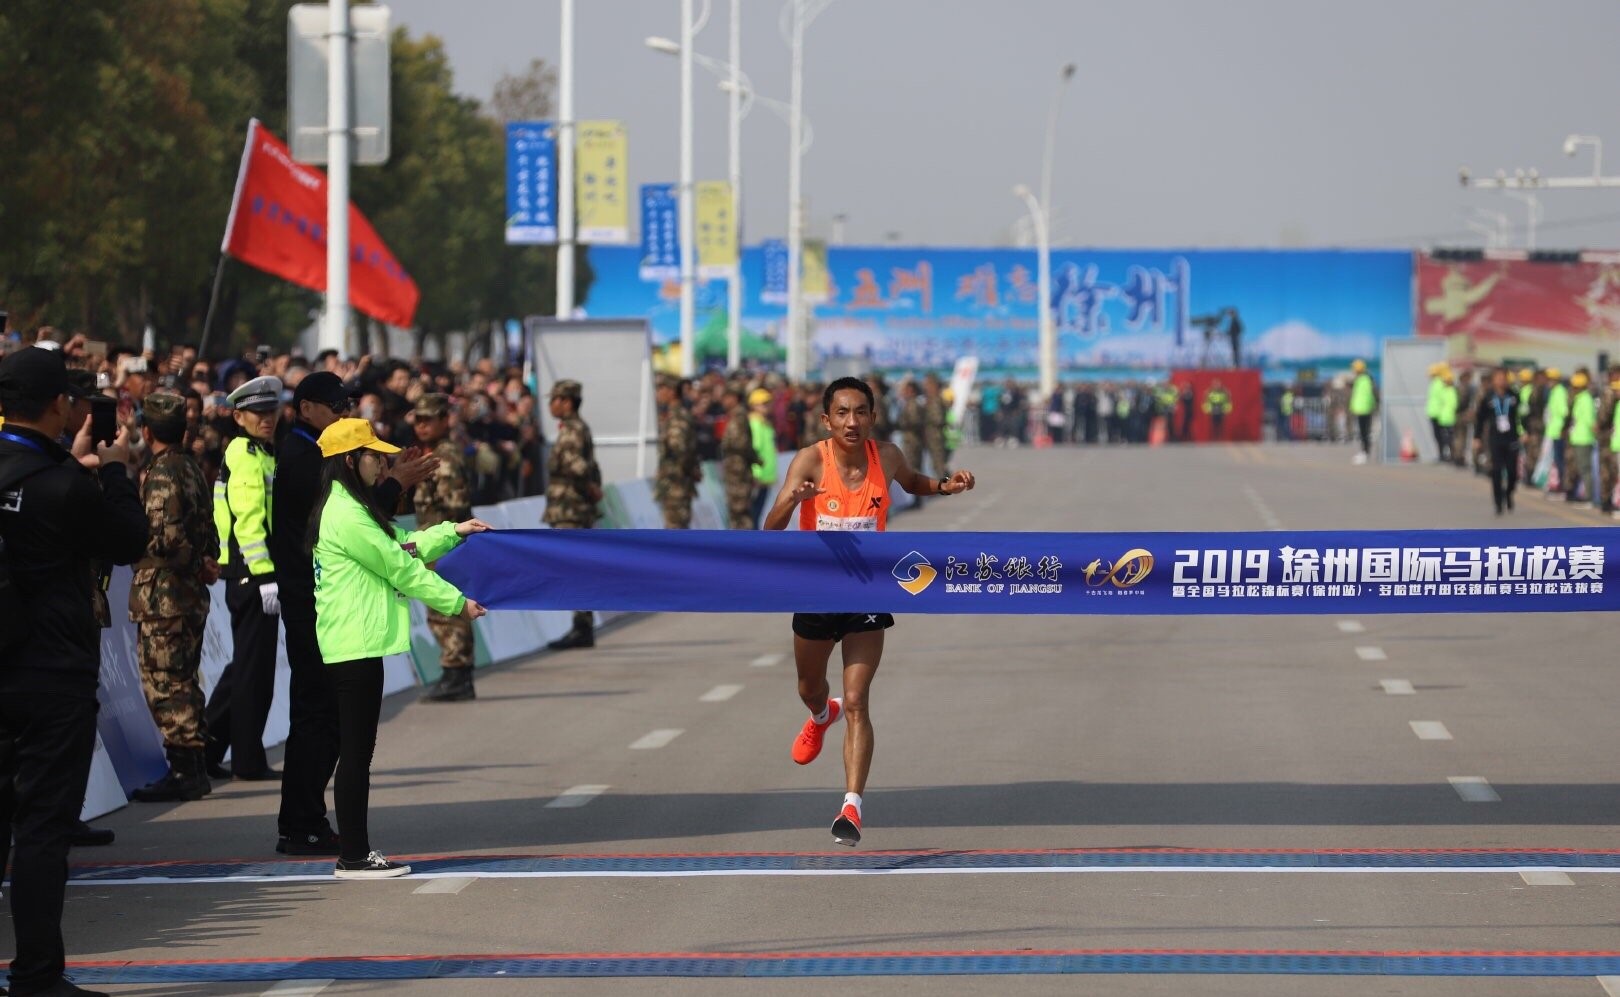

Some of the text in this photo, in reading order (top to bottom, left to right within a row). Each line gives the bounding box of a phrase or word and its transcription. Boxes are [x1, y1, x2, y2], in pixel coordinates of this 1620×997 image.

[1173, 544, 1605, 583] 2019 徐州国际马拉松赛
[945, 583, 1063, 595] BANK OF JIANGSU
